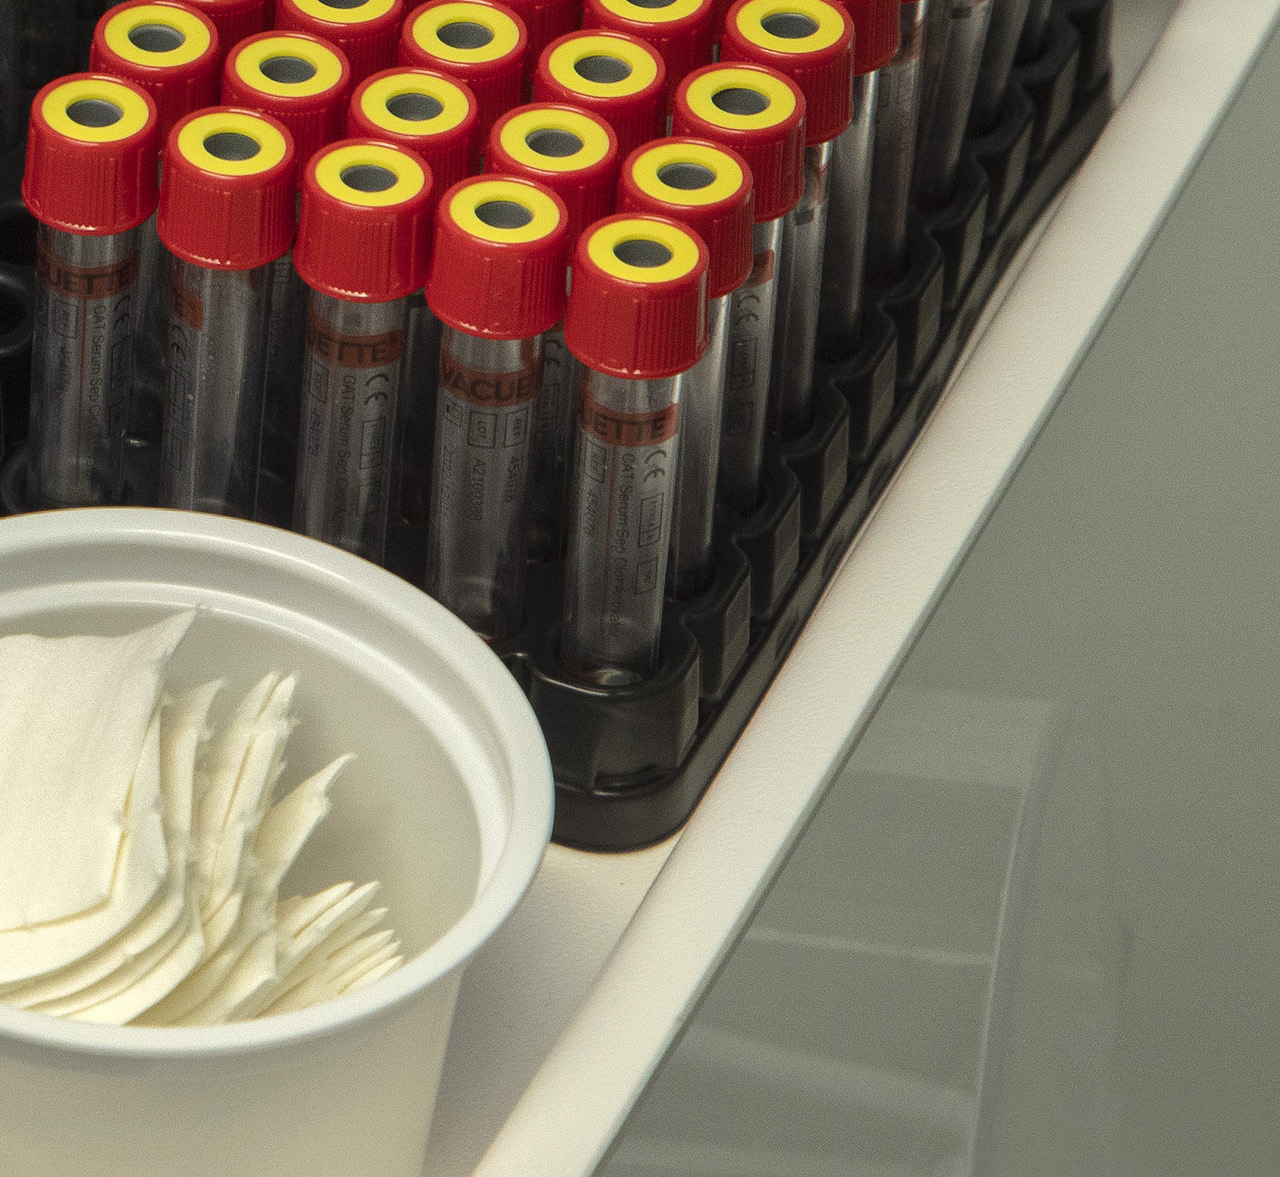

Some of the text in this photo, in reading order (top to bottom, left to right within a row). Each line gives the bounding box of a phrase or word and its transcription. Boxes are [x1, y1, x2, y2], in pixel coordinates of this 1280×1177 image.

[92, 304, 107, 331] CAT
[621, 452, 637, 480] CAT
[617, 484, 633, 525] Serum
[613, 528, 630, 554] Sep
